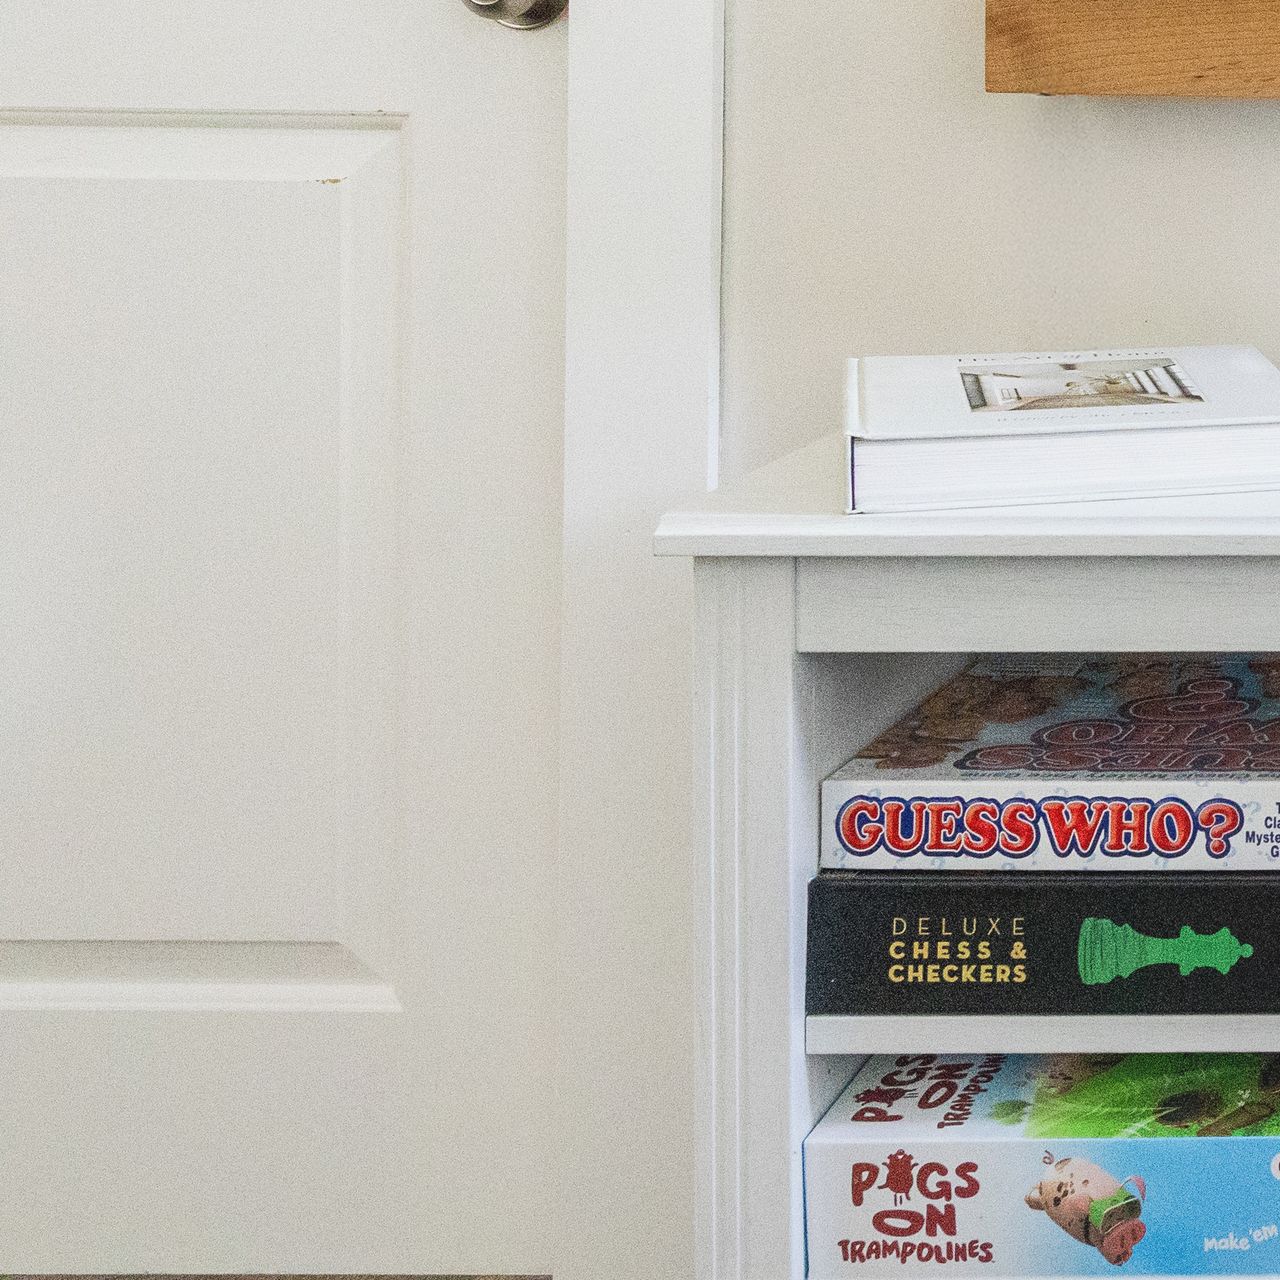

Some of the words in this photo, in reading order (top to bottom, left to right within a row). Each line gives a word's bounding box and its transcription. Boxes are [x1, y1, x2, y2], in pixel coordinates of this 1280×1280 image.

[836, 796, 1040, 858] GUESS
[1040, 796, 1244, 859] WHO?
[892, 917, 1025, 936] DELUXE
[889, 941, 992, 960] CHESS
[1010, 941, 1027, 960] &
[888, 964, 1027, 983] CHECKERS
[917, 1062, 975, 1110] ON
[872, 1203, 957, 1238] ON
[837, 1238, 994, 1265] TRAMPOLINES
[1203, 1232, 1250, 1253] make
